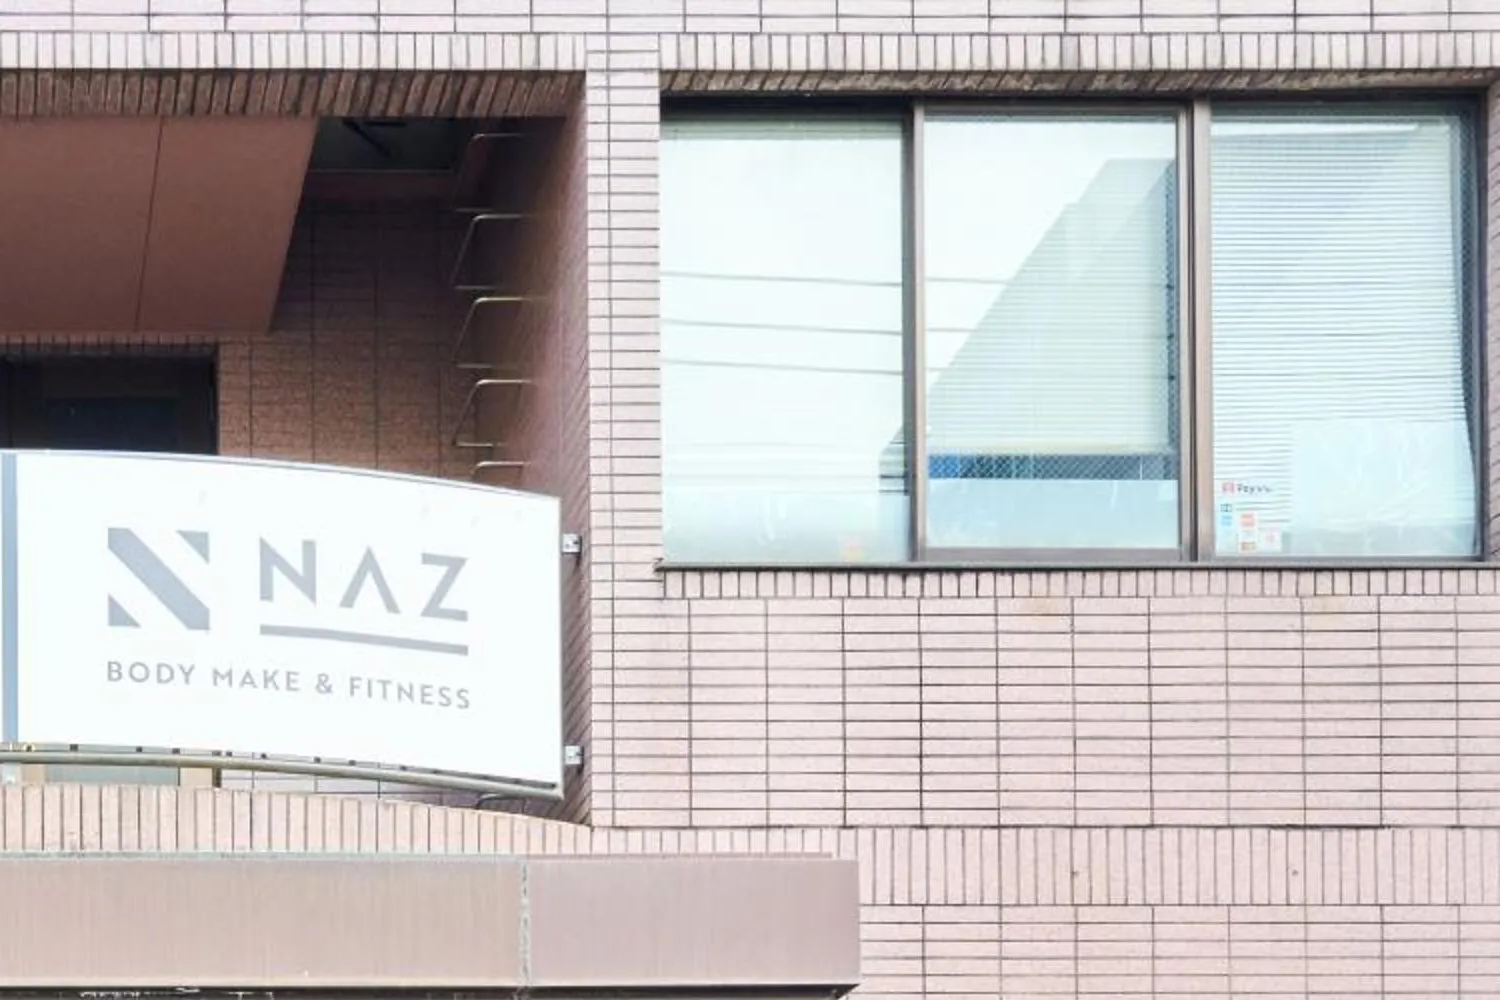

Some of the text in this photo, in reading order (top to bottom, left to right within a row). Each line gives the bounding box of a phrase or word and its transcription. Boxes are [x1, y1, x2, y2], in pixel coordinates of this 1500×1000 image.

[259, 536, 469, 622] NAZ
[107, 660, 471, 710] BODY MAKE & FITNESS
